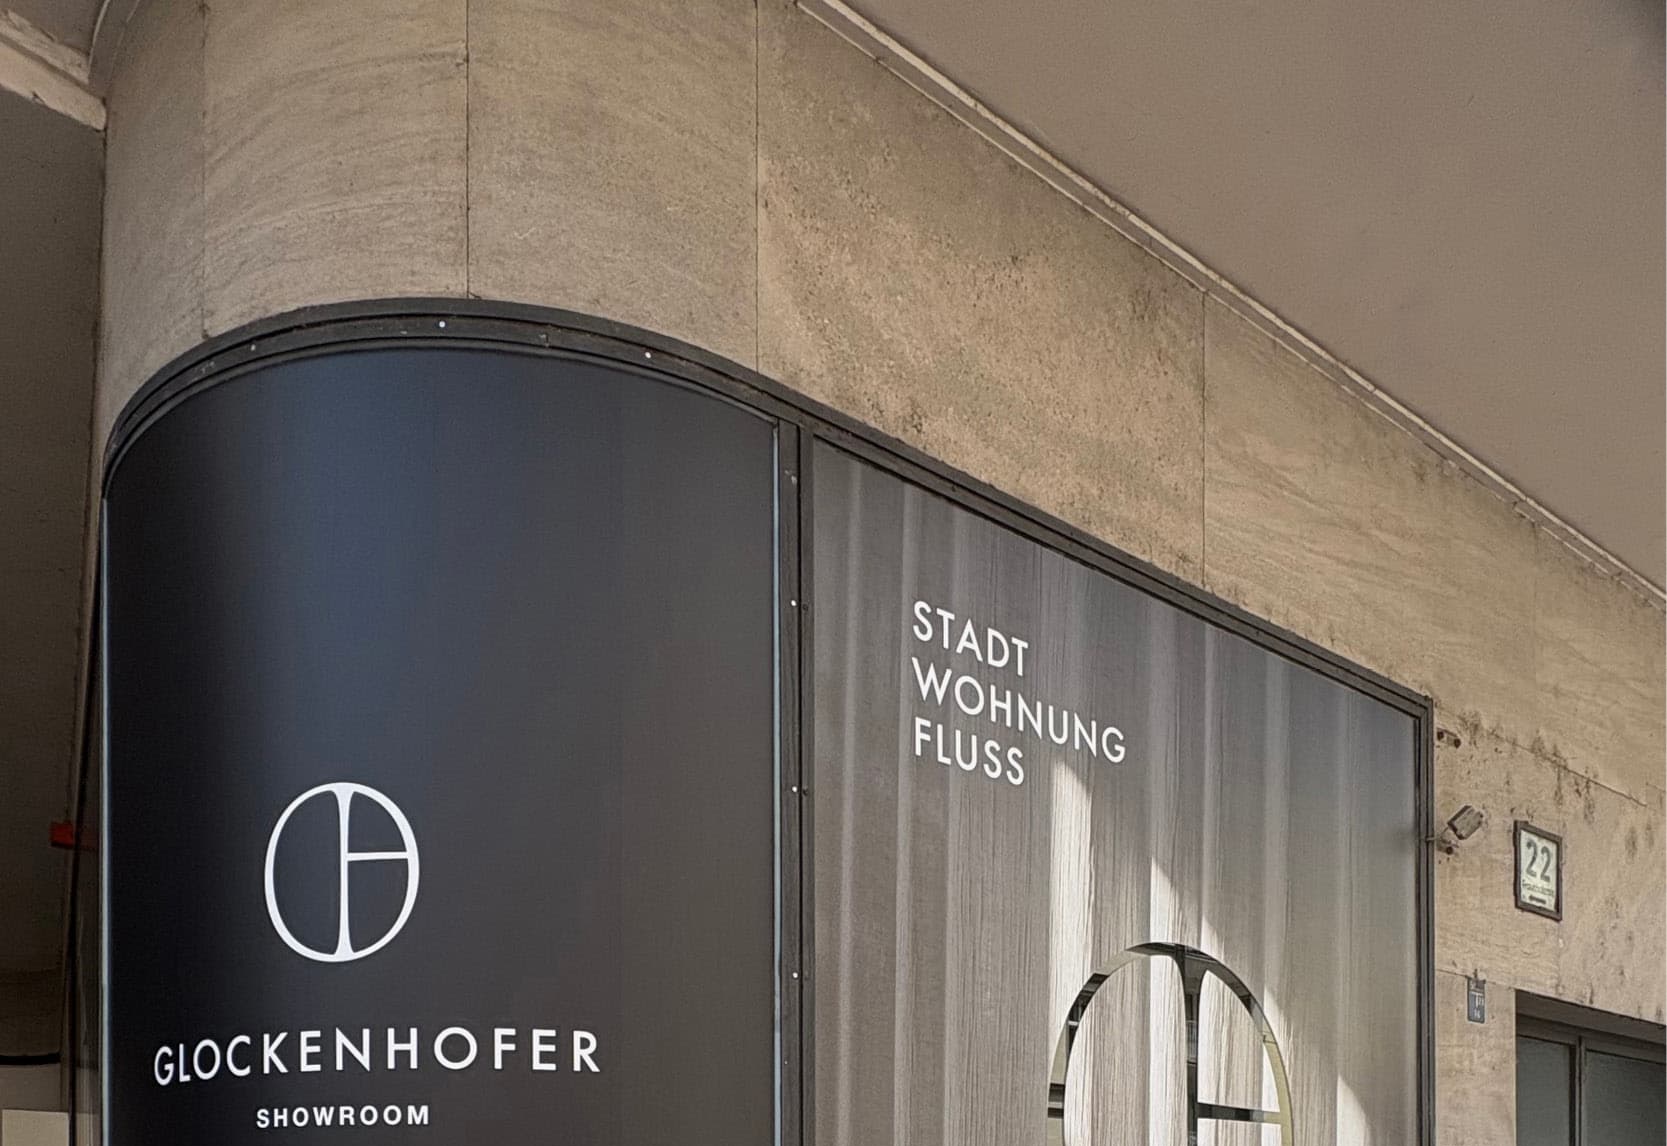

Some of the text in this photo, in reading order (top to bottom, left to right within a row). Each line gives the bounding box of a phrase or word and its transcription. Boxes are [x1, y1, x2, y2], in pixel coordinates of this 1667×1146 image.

[912, 600, 1029, 677] STADT
[911, 656, 1126, 763] WOHNUNG
[915, 716, 1025, 786] FLUSS
[1526, 839, 1551, 882] 22
[155, 1027, 600, 1085] GLOCKENHOFER
[257, 1105, 428, 1128] SHOWROOM
